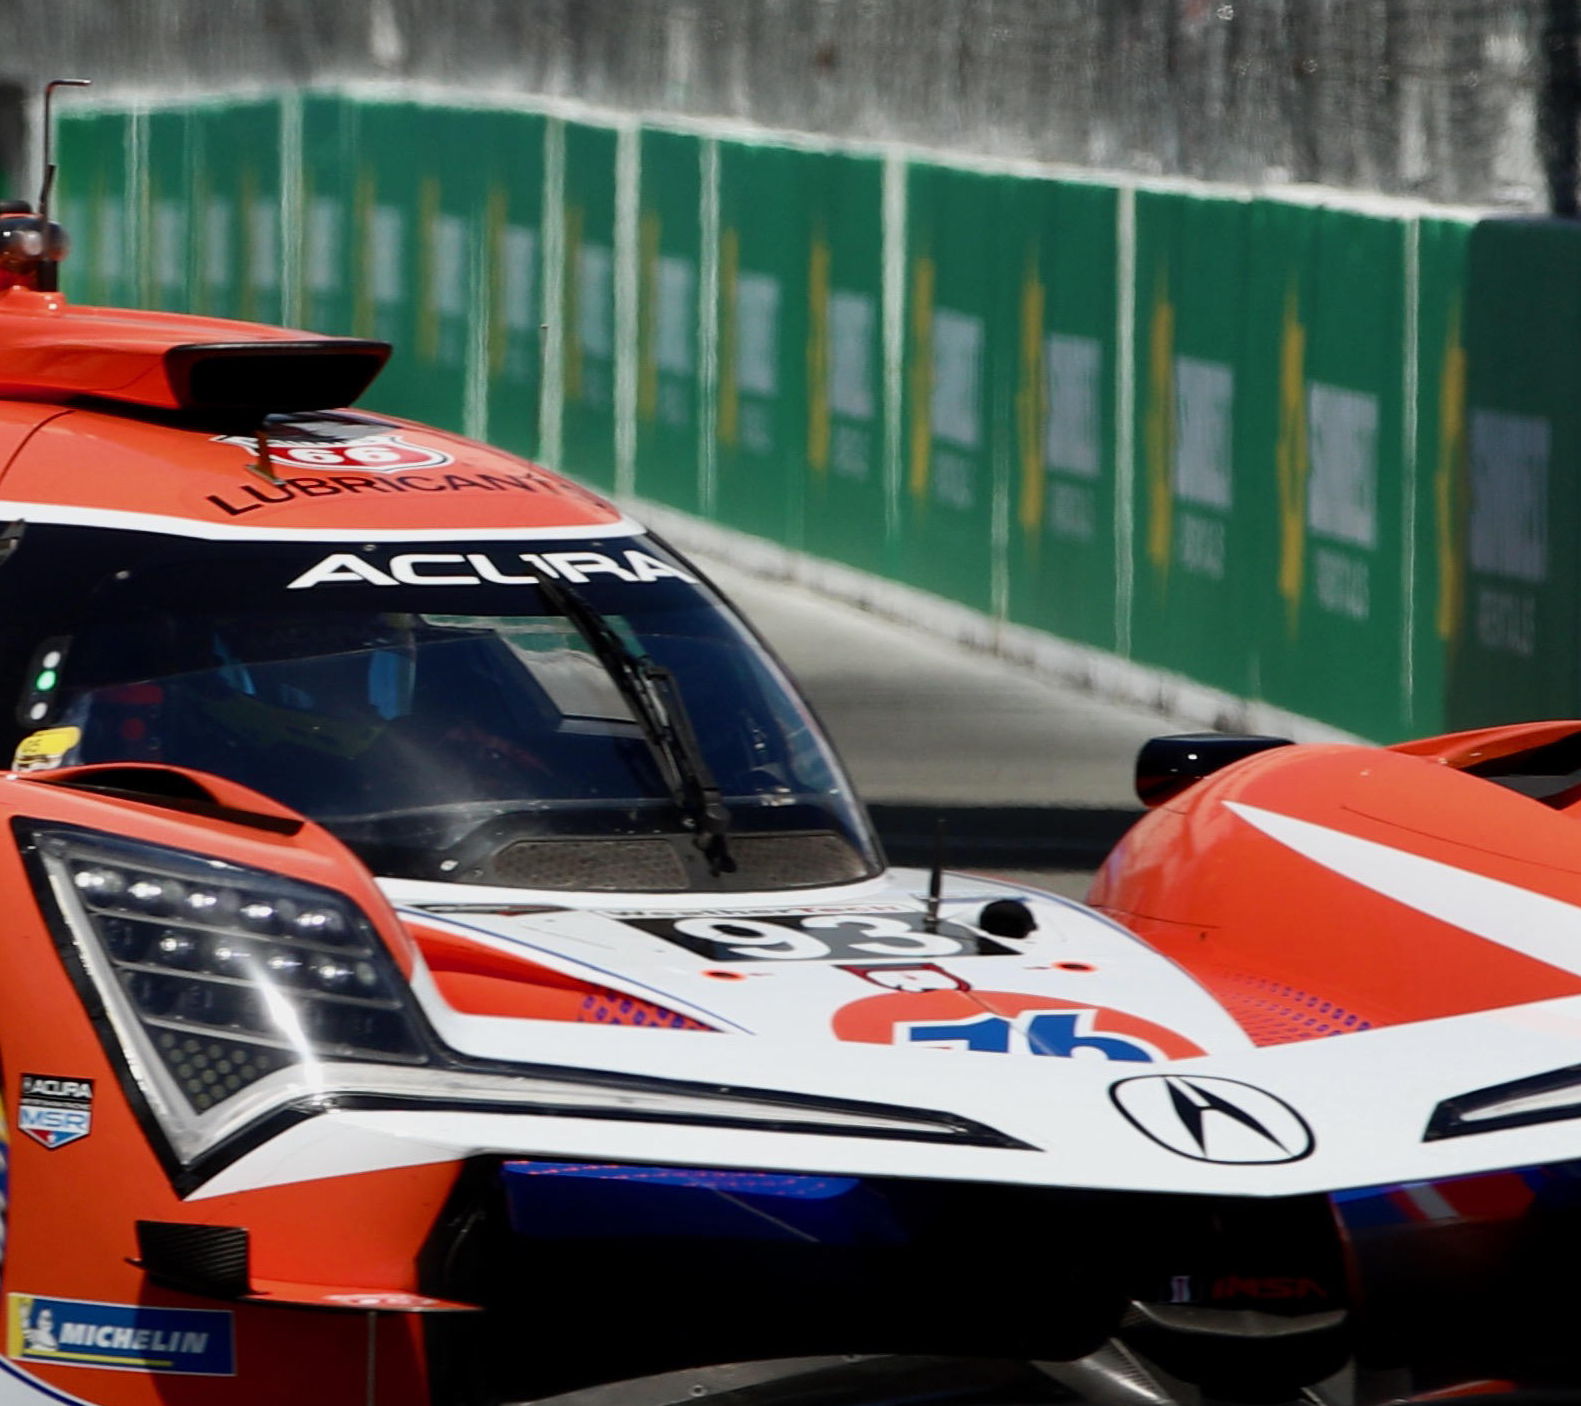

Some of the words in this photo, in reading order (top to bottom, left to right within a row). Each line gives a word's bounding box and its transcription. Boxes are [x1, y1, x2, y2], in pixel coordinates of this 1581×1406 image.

[288, 446, 401, 465] 66
[286, 550, 699, 589] ACURA
[672, 915, 963, 960] 93
[31, 1079, 93, 1098] ACURA
[21, 1109, 88, 1131] MSR
[58, 1322, 209, 1354] MICHELIN
